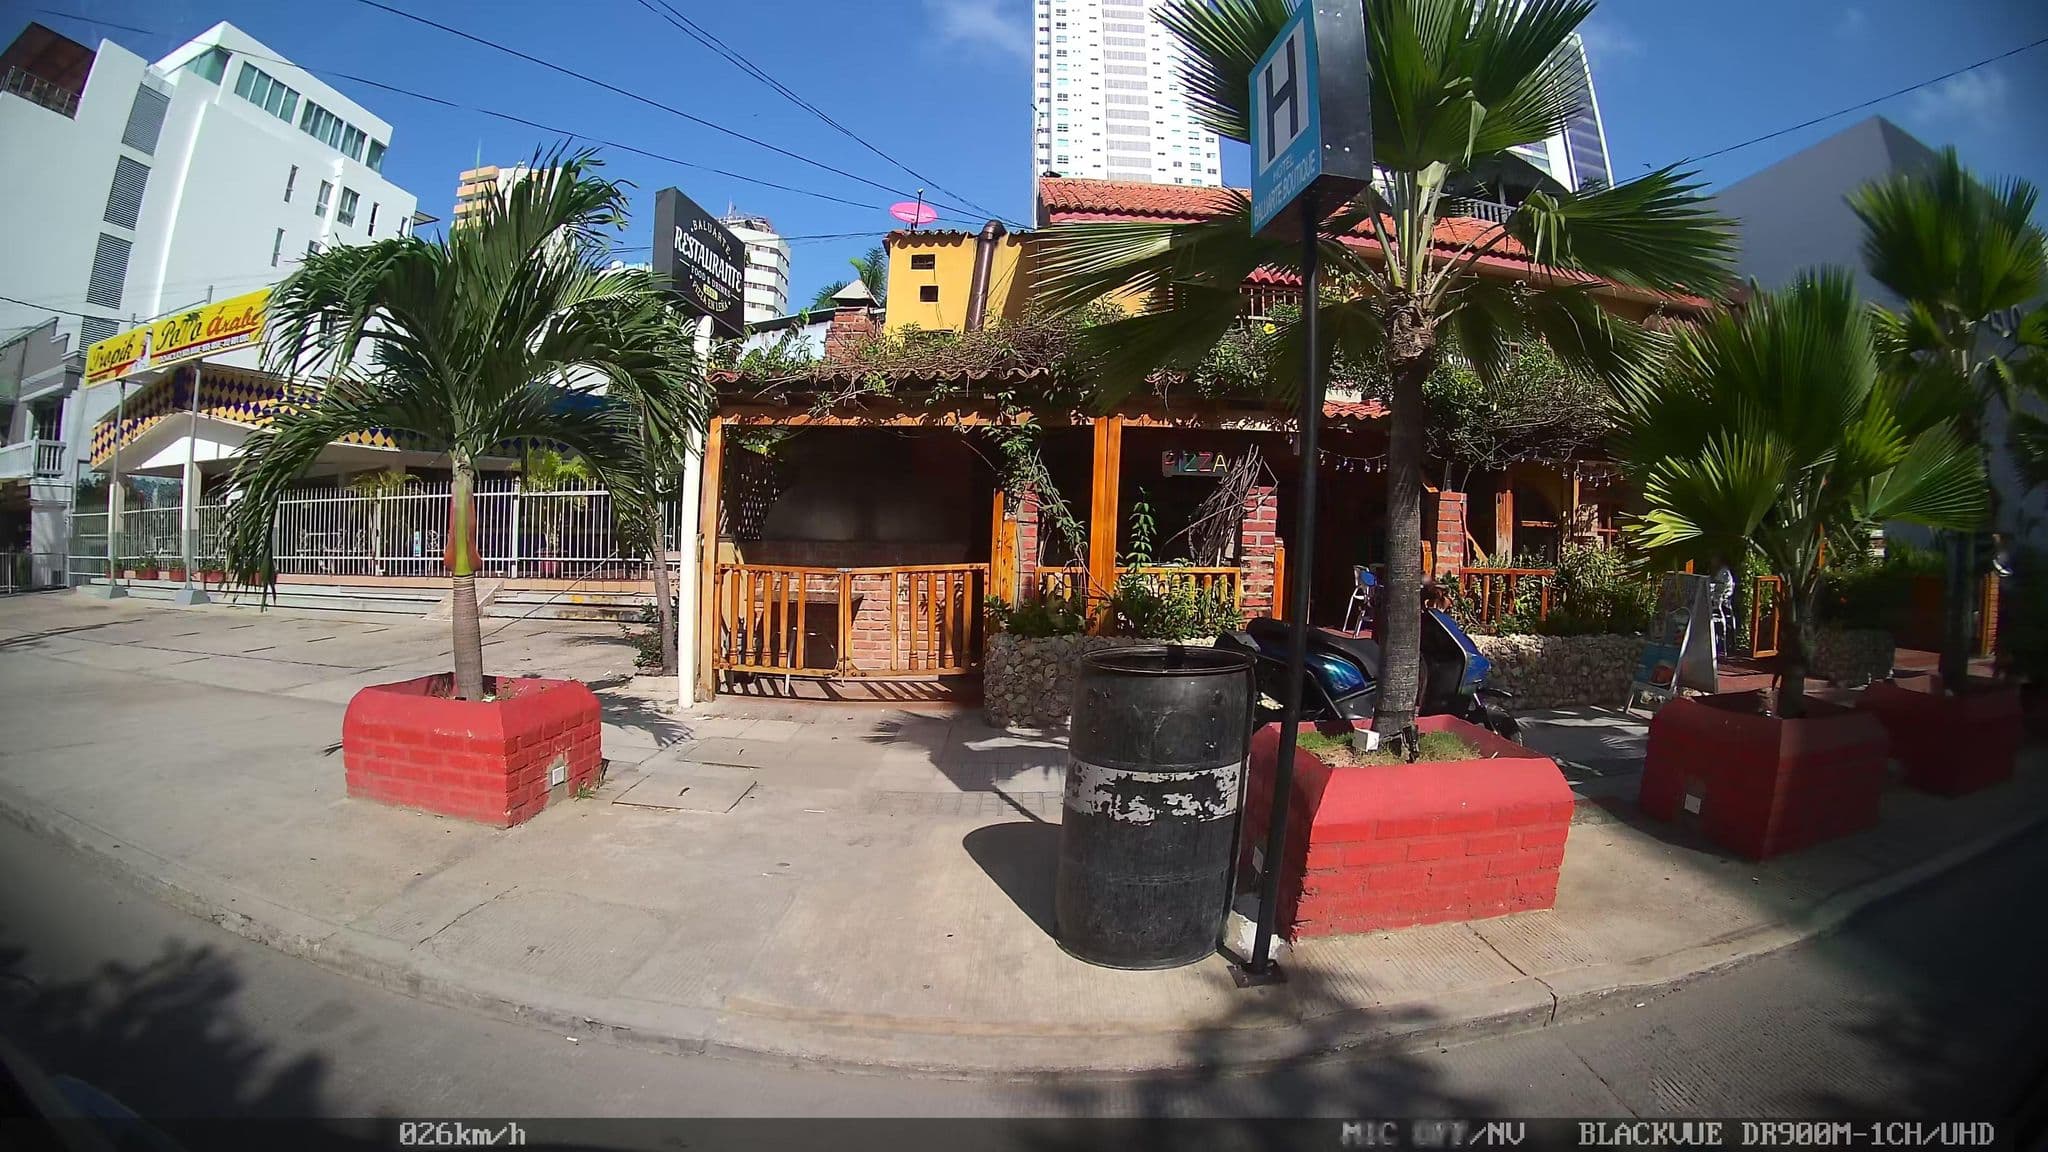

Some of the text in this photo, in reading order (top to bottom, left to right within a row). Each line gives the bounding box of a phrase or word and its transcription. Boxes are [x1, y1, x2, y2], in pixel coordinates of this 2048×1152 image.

[1265, 35, 1299, 163] H
[1272, 153, 1294, 182] HOTEL
[1254, 149, 1316, 227] BALUARTE BOUTIQUE
[692, 219, 731, 256] BALUARTE
[674, 225, 743, 293] RESTAURANTE
[691, 265, 706, 281] FOOD
[711, 279, 731, 298] DRINKS
[692, 280, 707, 305] PIZZA
[707, 298, 715, 311] EN
[1162, 451, 1228, 473] PIZZA
